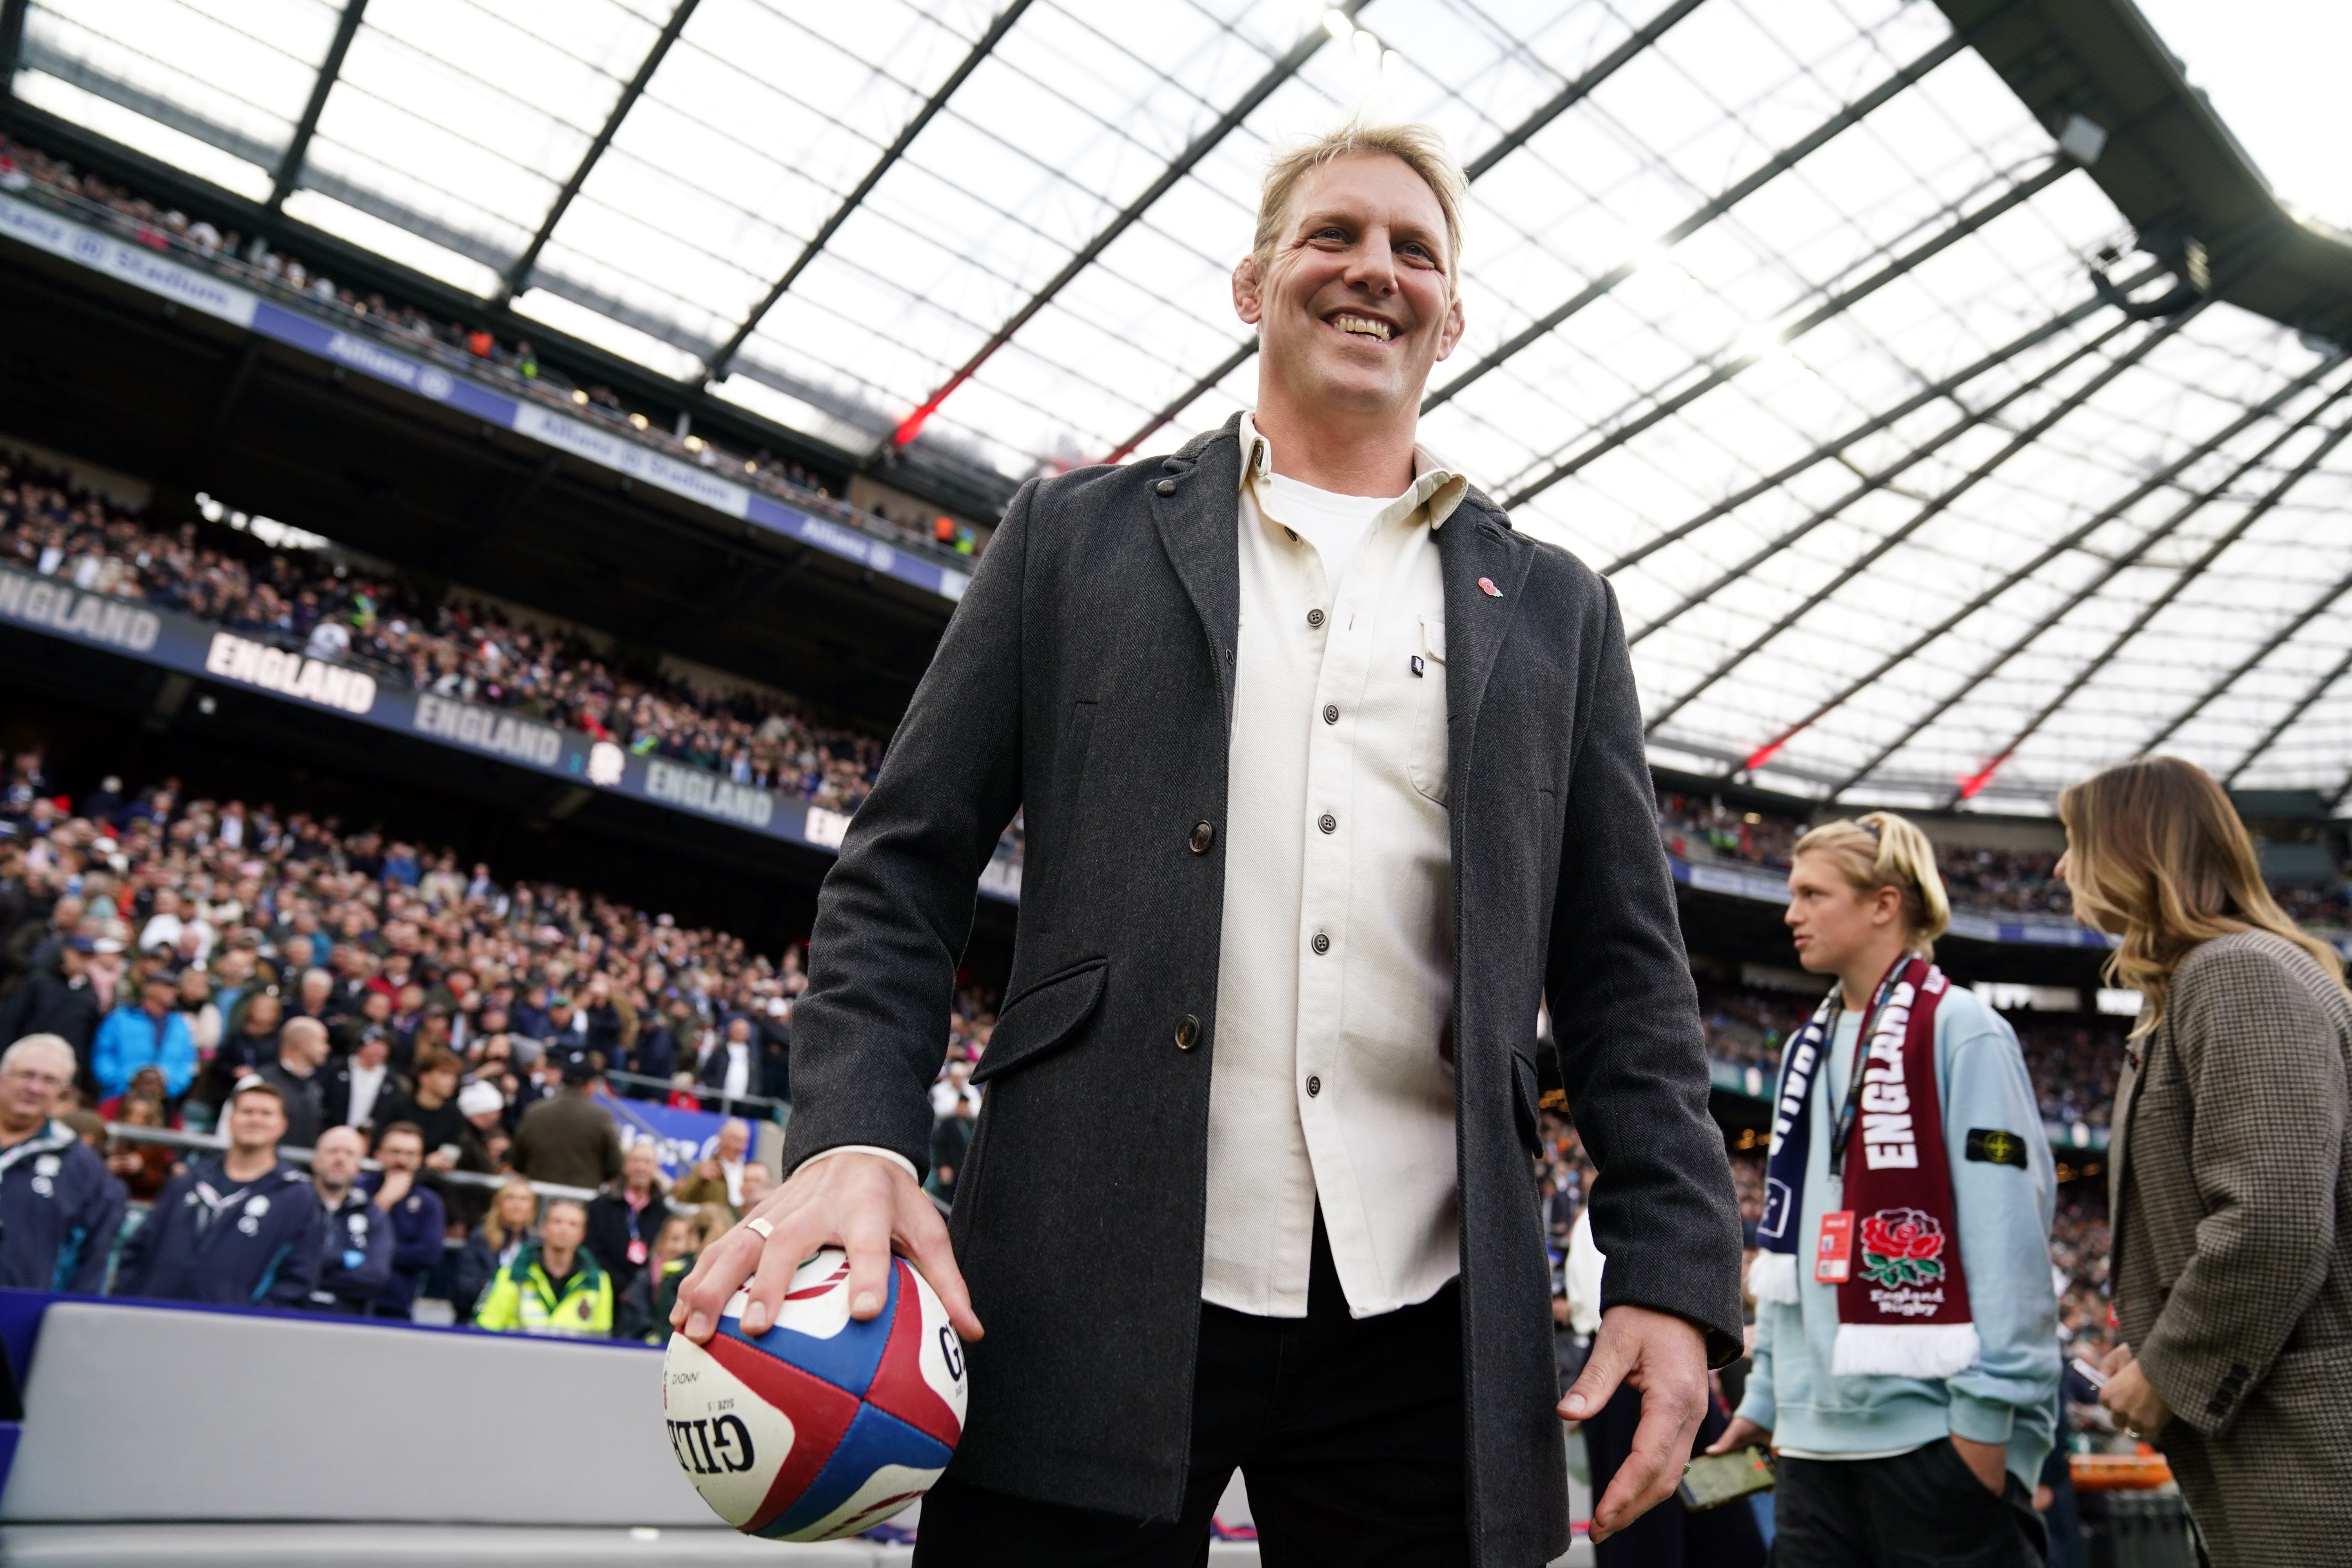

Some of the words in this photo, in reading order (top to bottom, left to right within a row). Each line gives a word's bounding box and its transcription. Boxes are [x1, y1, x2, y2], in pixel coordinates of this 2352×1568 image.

[0, 572, 160, 652] NGLAND
[206, 632, 377, 714] ENGLAND
[414, 693, 562, 768] ENGLAND
[646, 759, 775, 828] ENGLAND
[1861, 981, 1918, 1170] ENGLAND
[1869, 1287, 1945, 1303] England
[1878, 1301, 1938, 1317] Rugby
[667, 1414, 754, 1474] GILB
